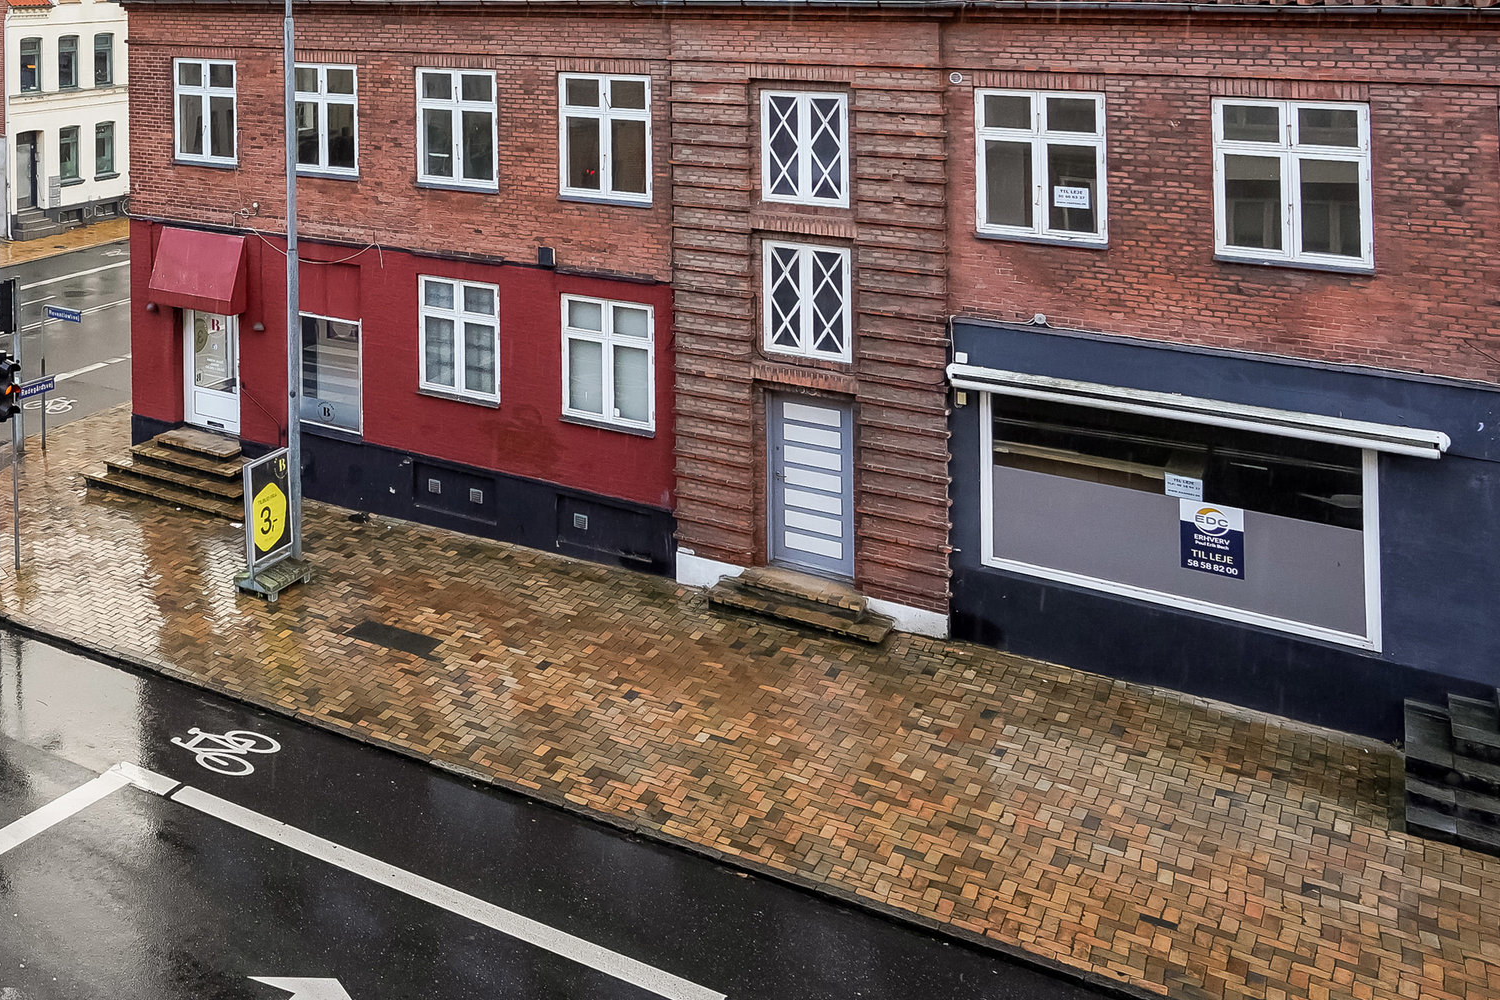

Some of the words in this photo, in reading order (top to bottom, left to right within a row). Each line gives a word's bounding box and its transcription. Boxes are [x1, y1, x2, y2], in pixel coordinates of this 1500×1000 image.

[211, 318, 220, 331] B
[323, 406, 331, 416] B
[278, 458, 286, 472] B
[1195, 514, 1229, 528] EDC
[1193, 533, 1231, 545] ERHVERV
[1190, 548, 1208, 560] TIL
[1209, 552, 1234, 565] LEJE
[1187, 559, 1199, 567] 58
[1200, 561, 1212, 570] 58
[1213, 564, 1225, 573] 82
[1225, 567, 1238, 575] 00
